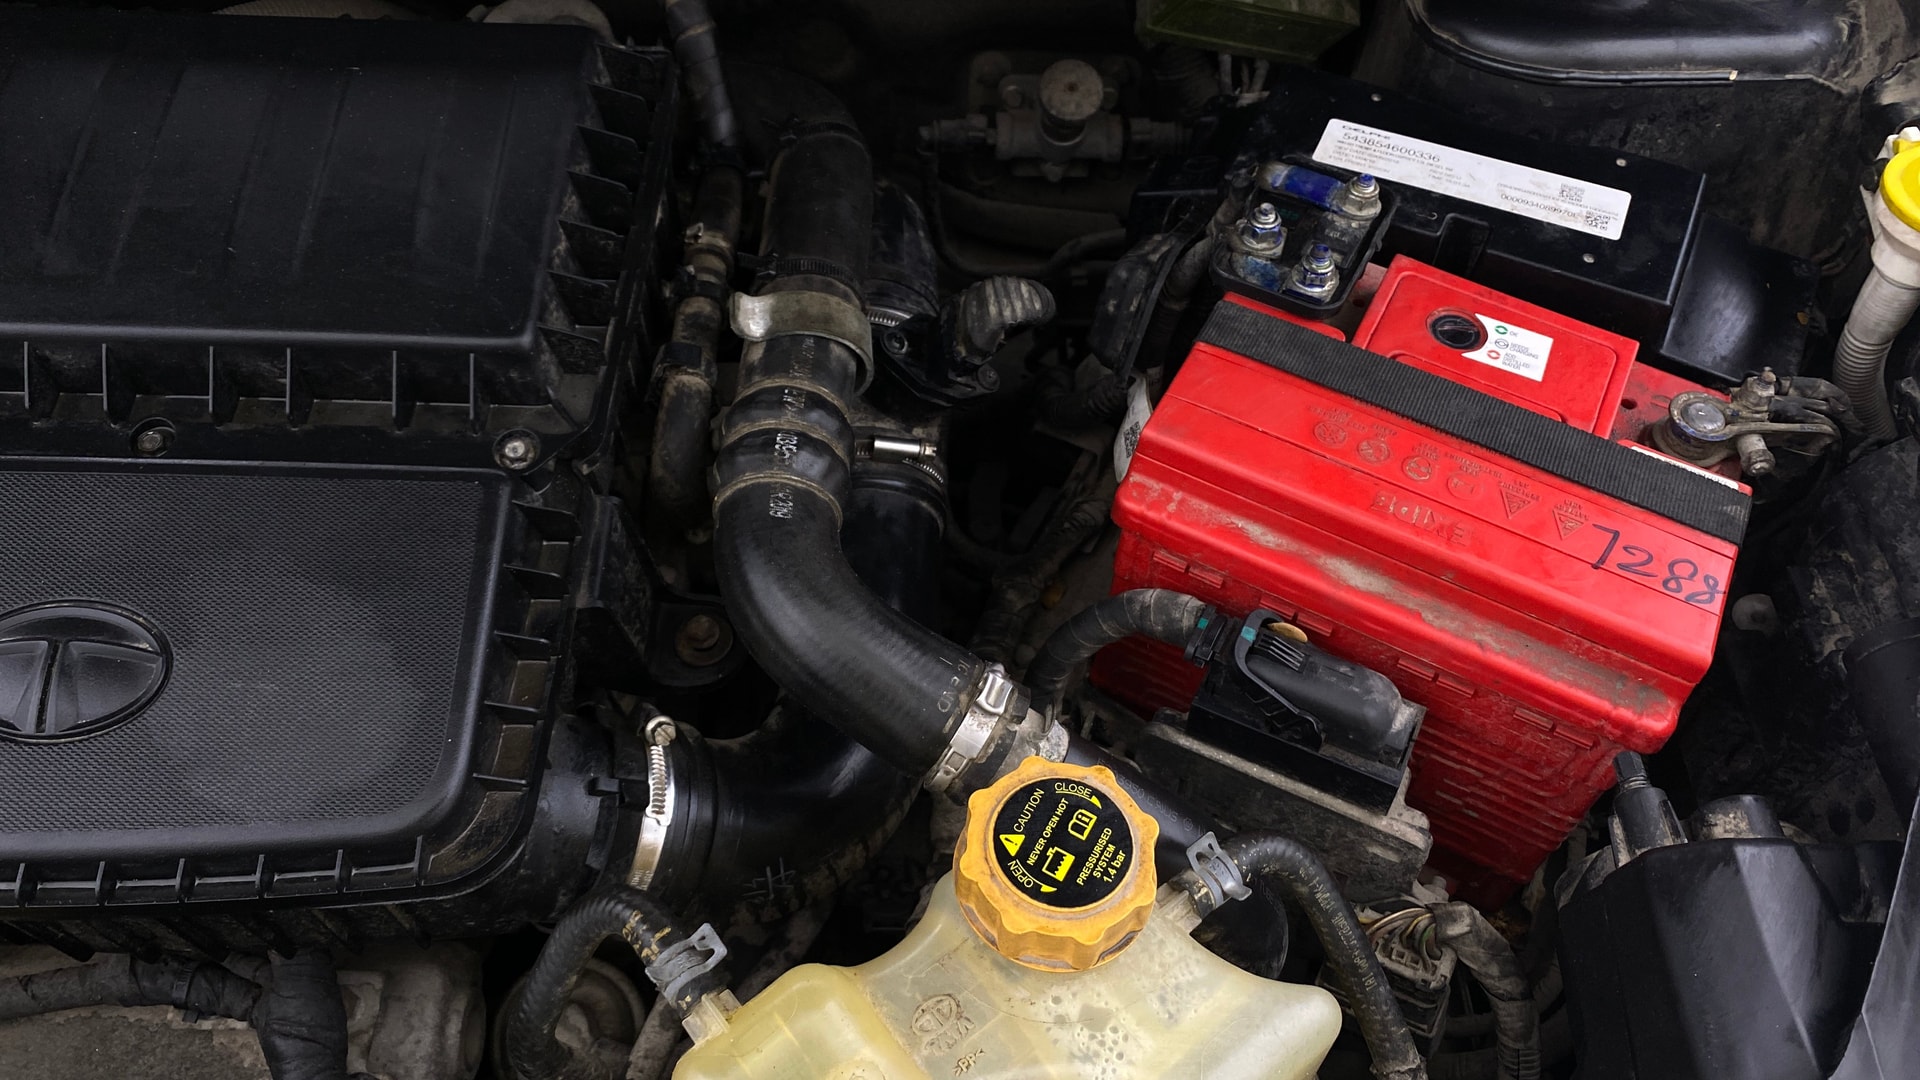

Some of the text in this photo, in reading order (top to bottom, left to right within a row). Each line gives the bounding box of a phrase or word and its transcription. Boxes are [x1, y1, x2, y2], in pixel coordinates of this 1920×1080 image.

[1342, 132, 1441, 162] 543854600336
[1371, 491, 1470, 547] EXIDE
[1055, 782, 1092, 797] CLOSE
[1013, 788, 1044, 832] CAUTION
[1026, 797, 1069, 866] NEVER OPEN HOT
[1076, 827, 1112, 885] PRESSURISED
[1093, 843, 1116, 878] SYSTEM
[1103, 850, 1126, 883] 1.4 bar
[1007, 860, 1034, 888] OPEN
